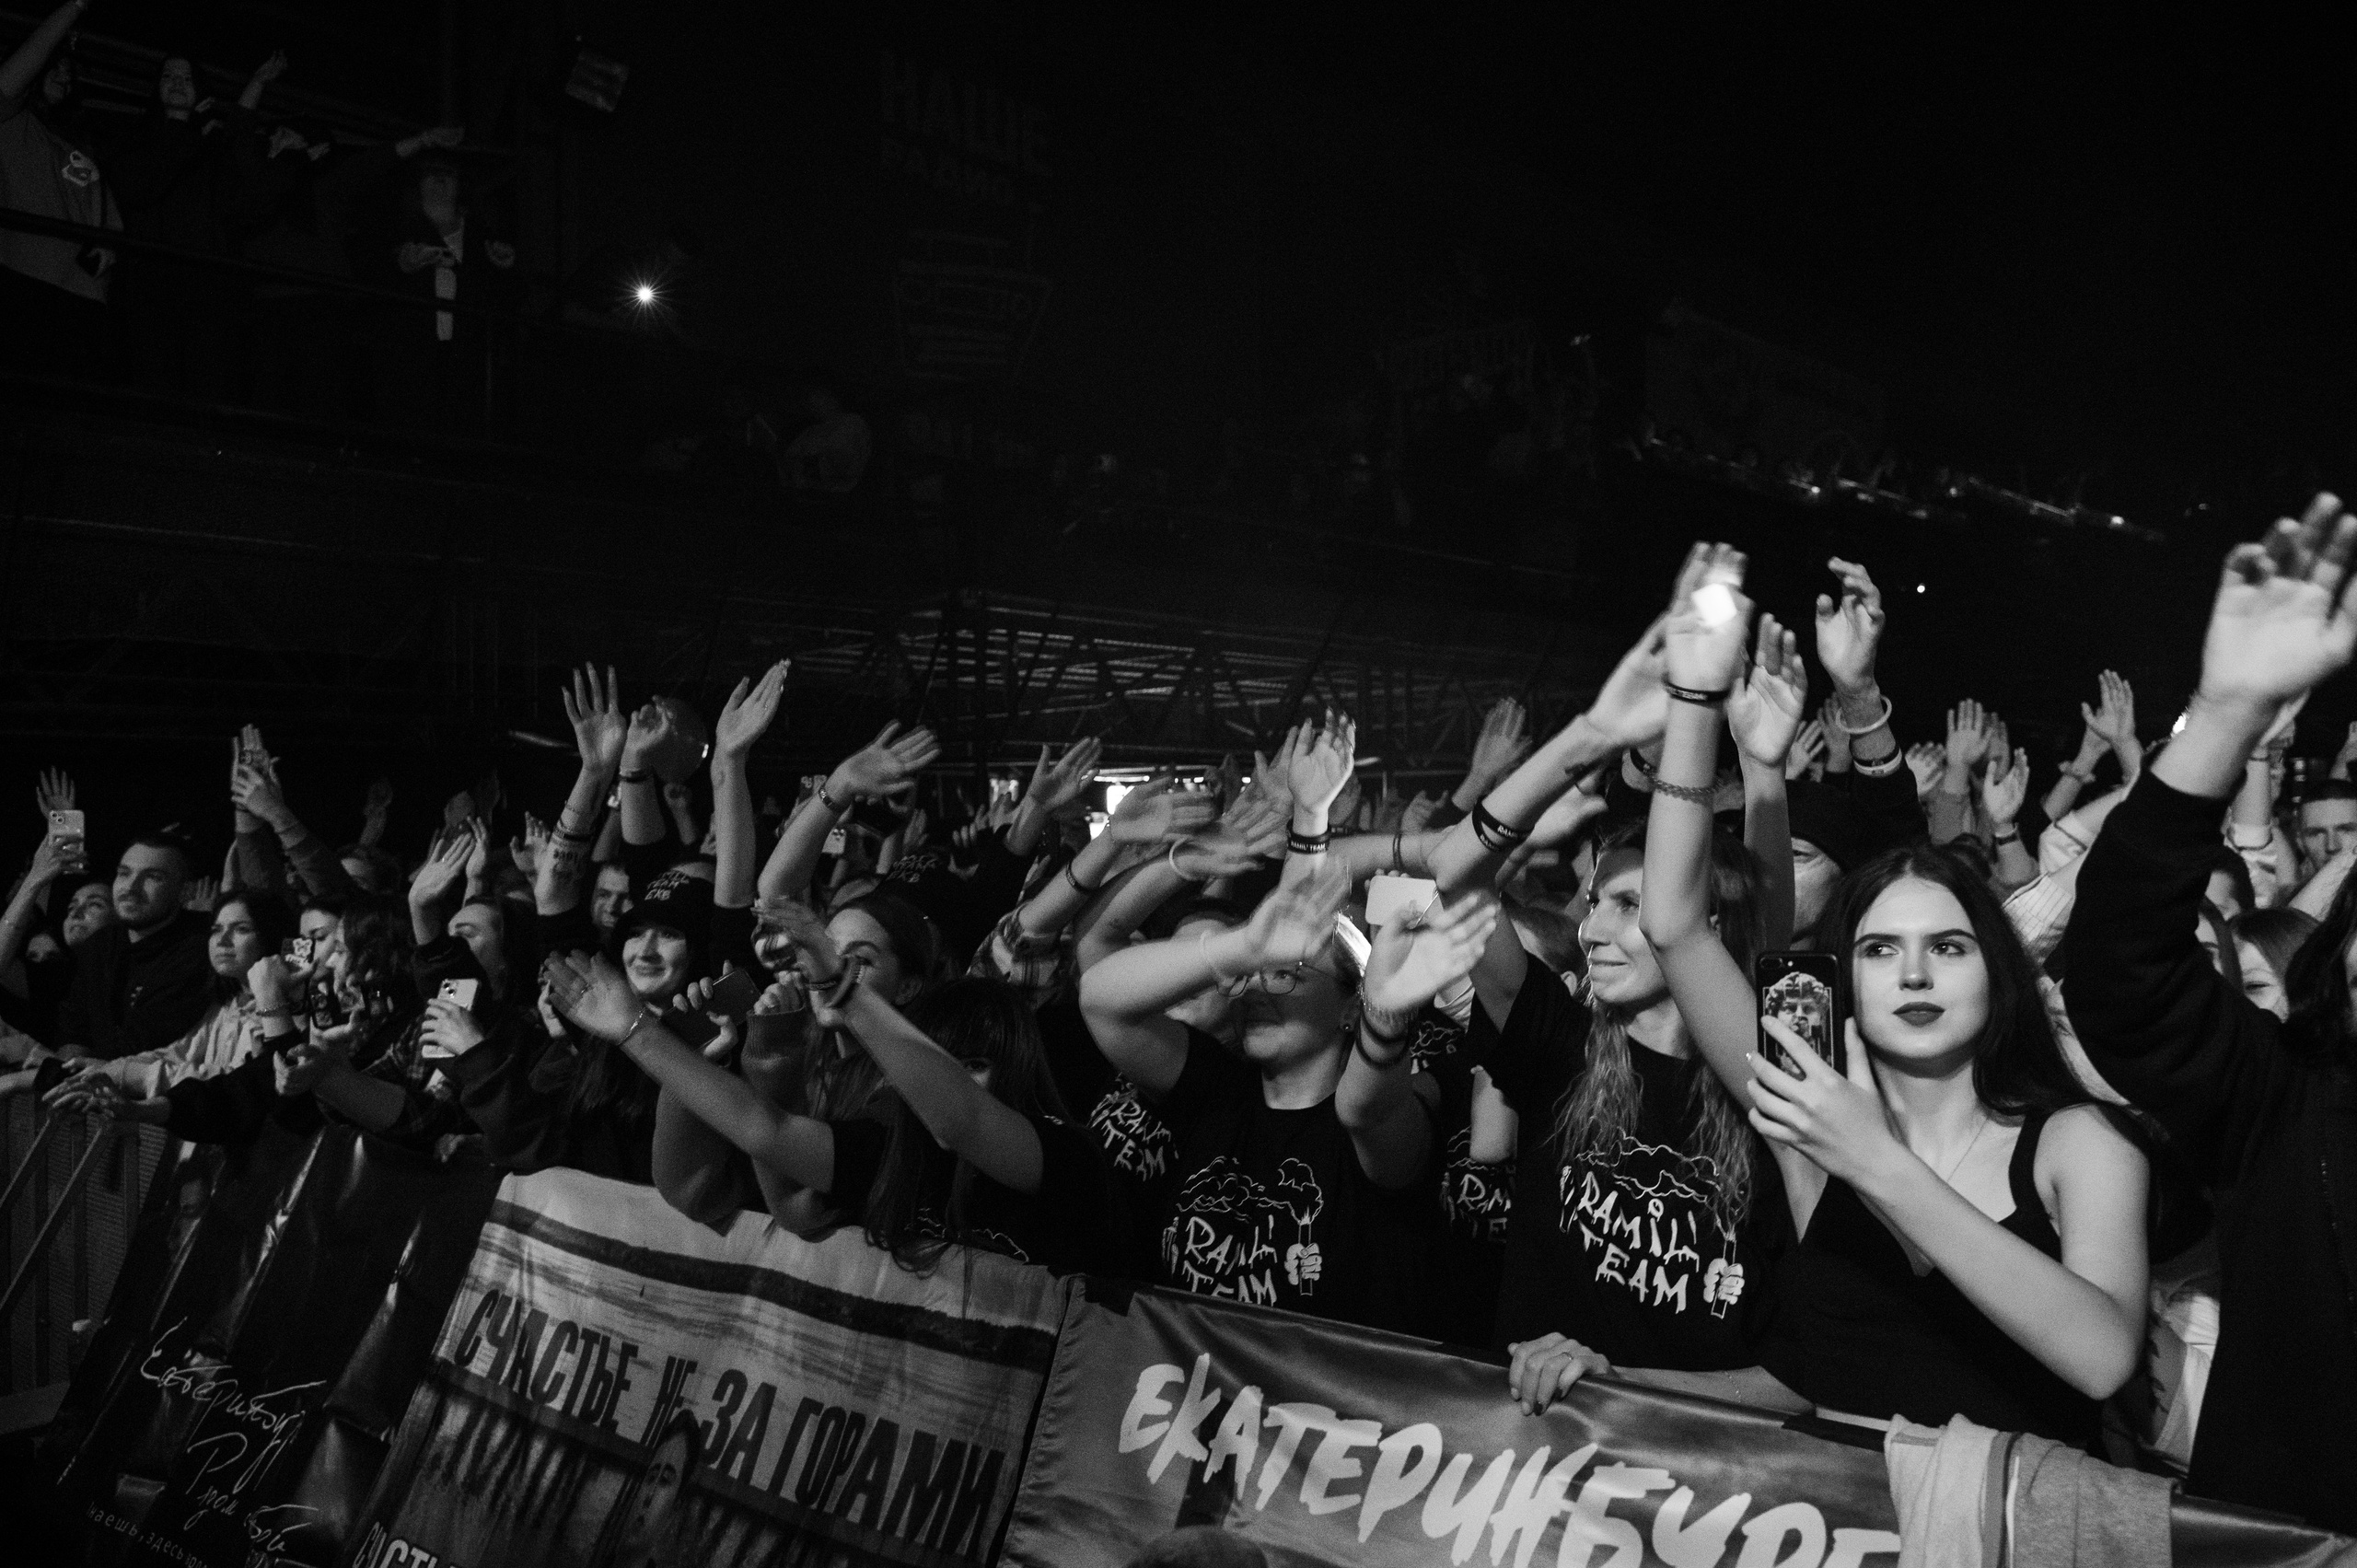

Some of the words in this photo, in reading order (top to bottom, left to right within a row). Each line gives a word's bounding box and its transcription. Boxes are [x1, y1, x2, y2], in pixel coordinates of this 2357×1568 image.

[454, 1288, 638, 1434] СЧАСТЬЕ
[698, 1368, 778, 1490] ЗА
[772, 1394, 1006, 1556] ГОРАМИ
